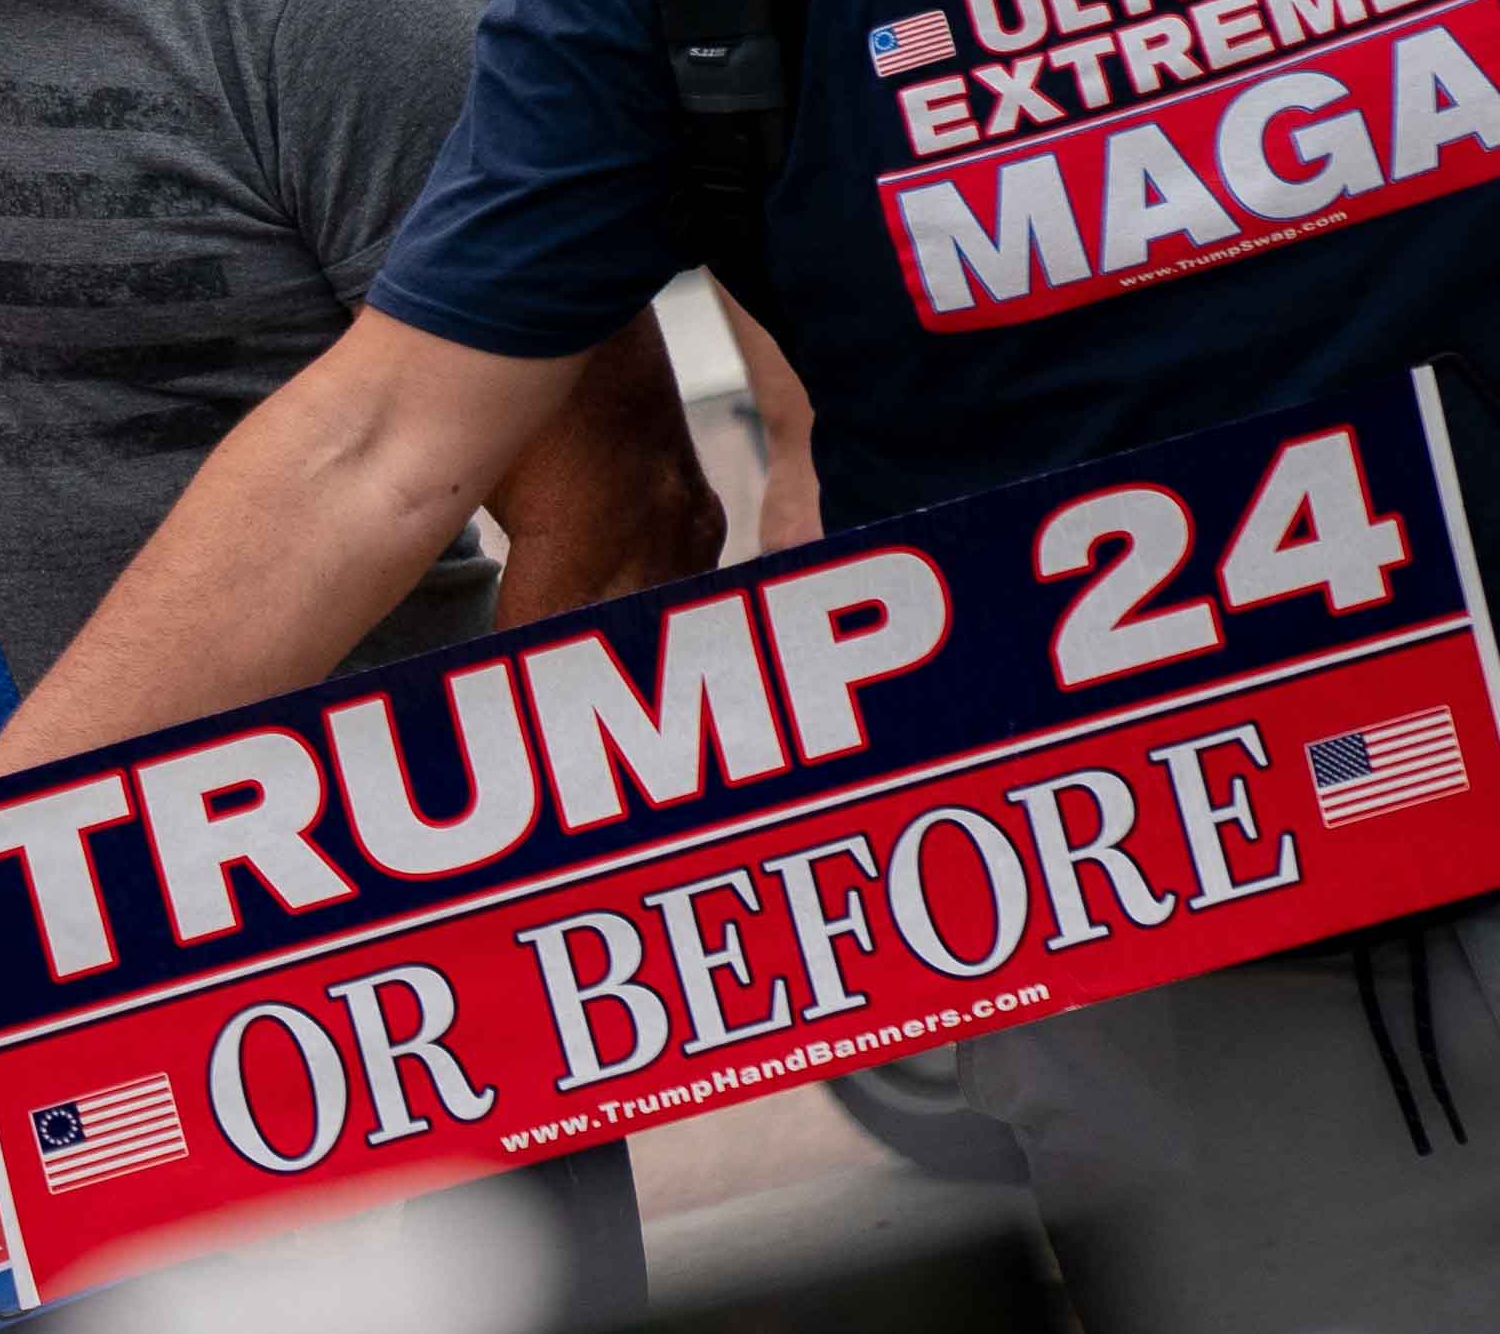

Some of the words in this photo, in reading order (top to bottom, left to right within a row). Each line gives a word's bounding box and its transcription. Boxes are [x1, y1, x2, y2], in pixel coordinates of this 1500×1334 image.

[898, 24, 1500, 316] MAGA
[1119, 209, 1348, 289] www.TrumpSwag.com
[1031, 422, 1413, 694] 24
[205, 958, 497, 1175] OR
[517, 719, 1304, 1098] BEFORE
[501, 979, 1051, 1154] www.TrumpHandBanners.com
